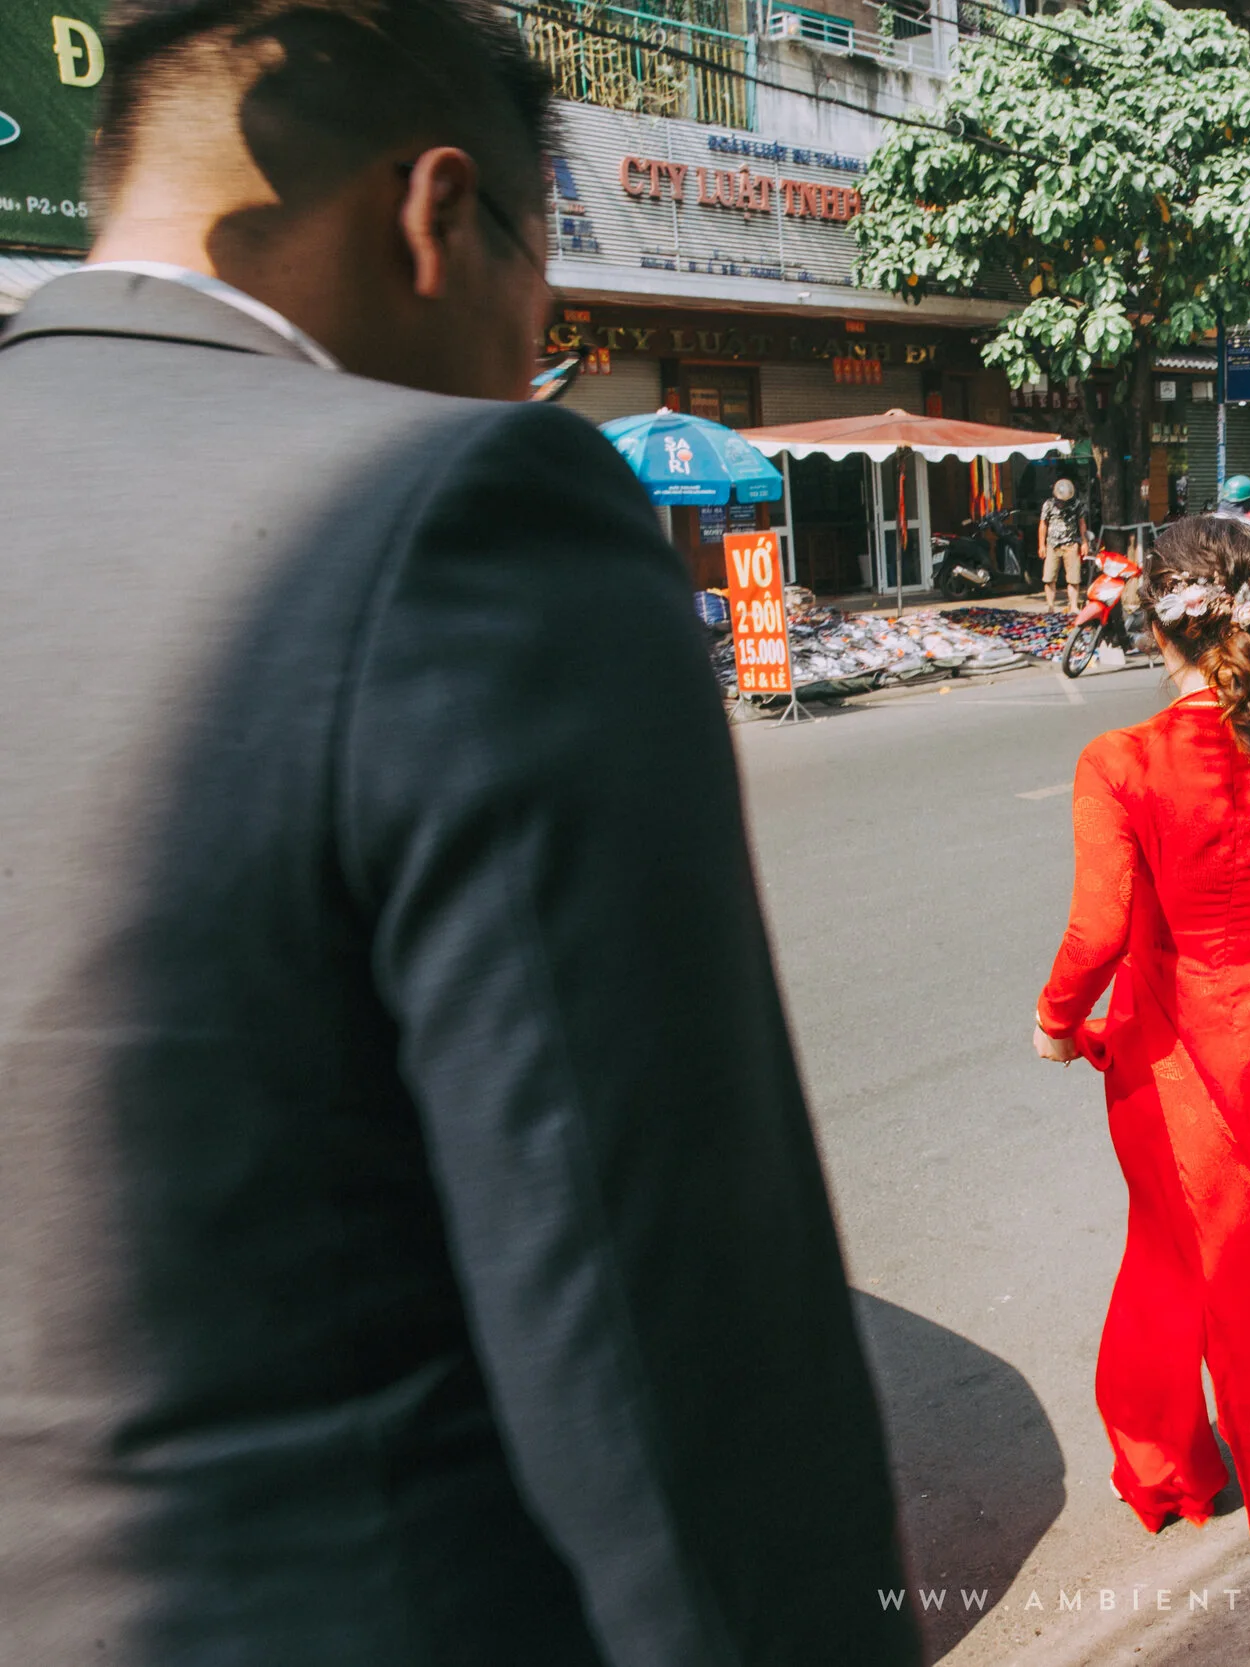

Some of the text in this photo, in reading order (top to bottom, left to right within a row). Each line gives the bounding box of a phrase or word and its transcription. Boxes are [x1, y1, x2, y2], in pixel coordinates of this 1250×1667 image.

[52, 15, 105, 88] Đ
[619, 156, 862, 222] CTY LUẬT TNHH
[597, 326, 657, 350] TY
[732, 536, 773, 588] VỚ
[736, 591, 783, 633] 2 ĐÔI
[738, 638, 785, 665] 15.000
[758, 672, 769, 687] &
